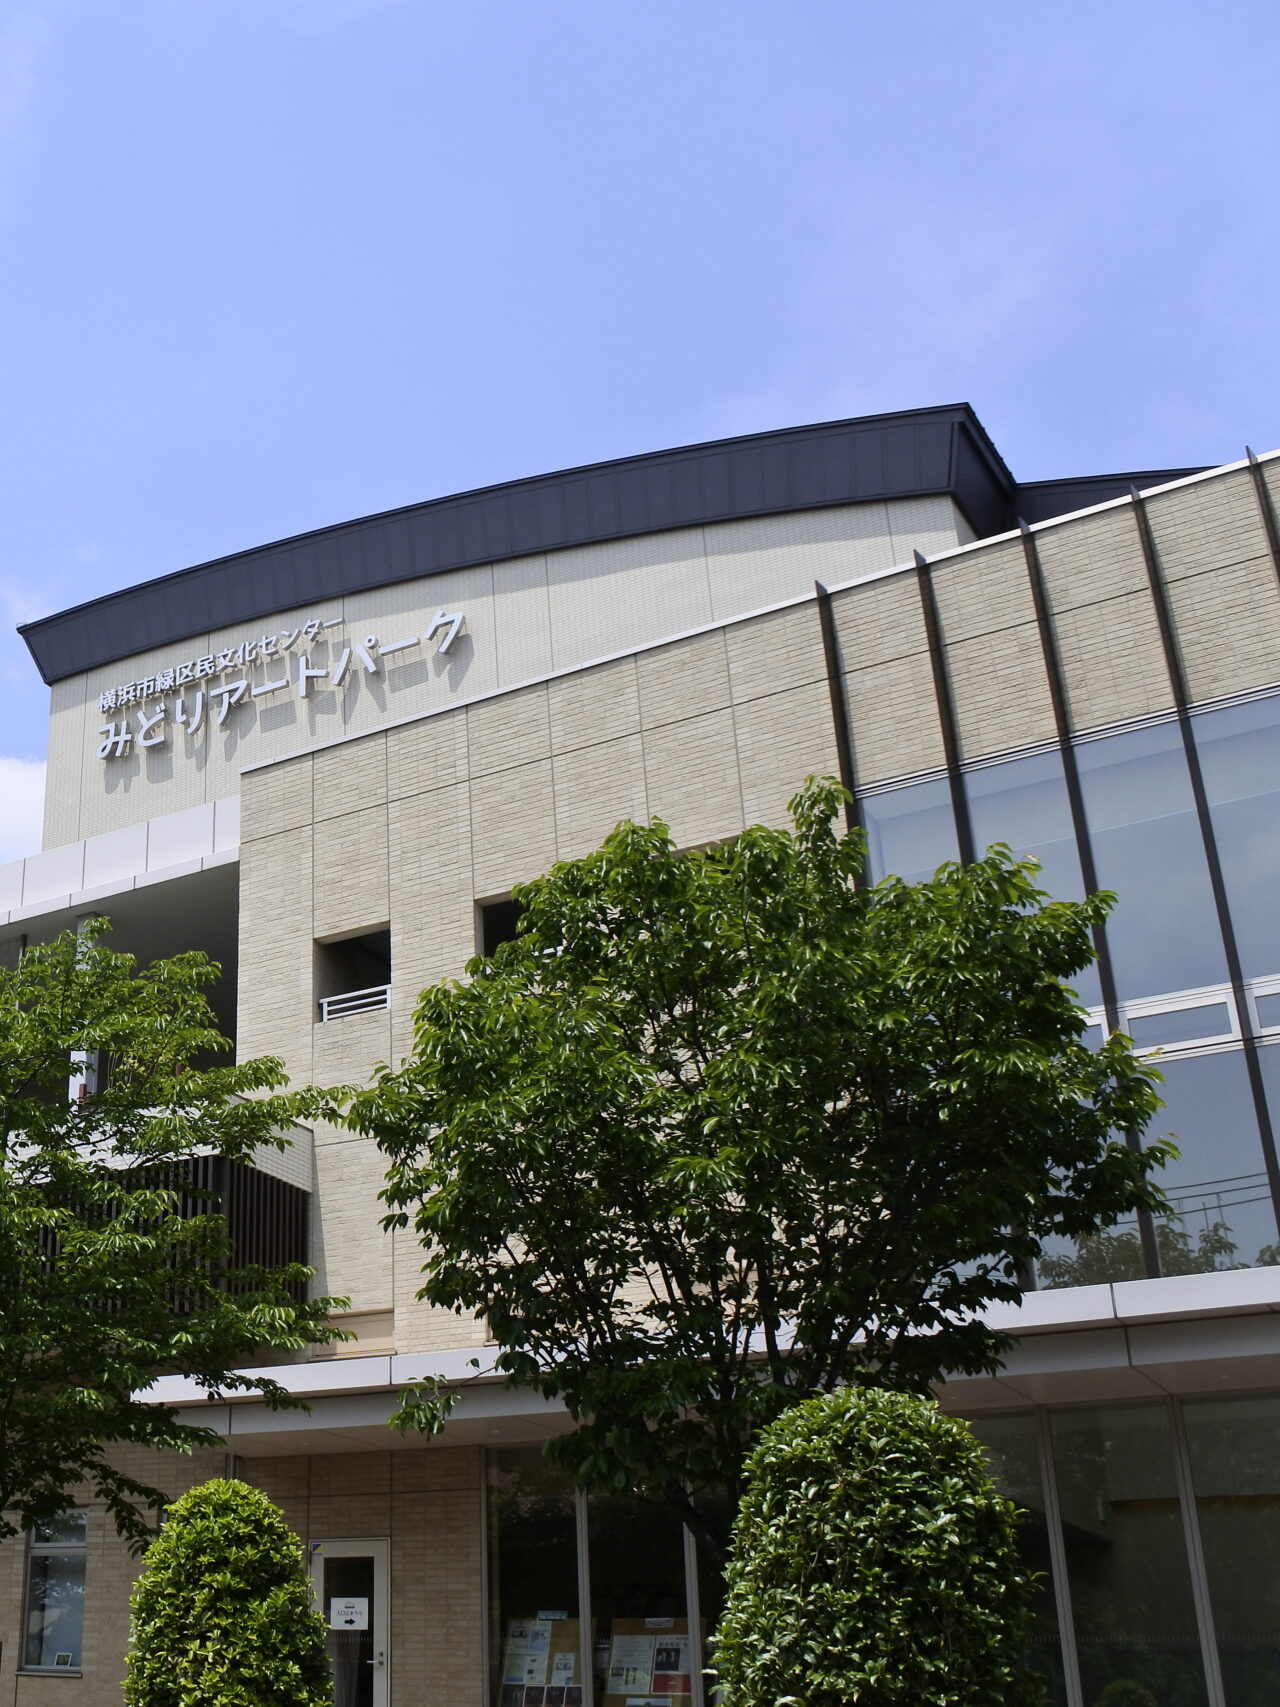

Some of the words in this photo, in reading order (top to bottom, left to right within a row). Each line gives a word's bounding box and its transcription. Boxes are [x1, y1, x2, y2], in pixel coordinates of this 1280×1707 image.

[96, 609, 465, 760] みどりアートパーク
[97, 617, 344, 713] 横浜市緑区民文化センター
